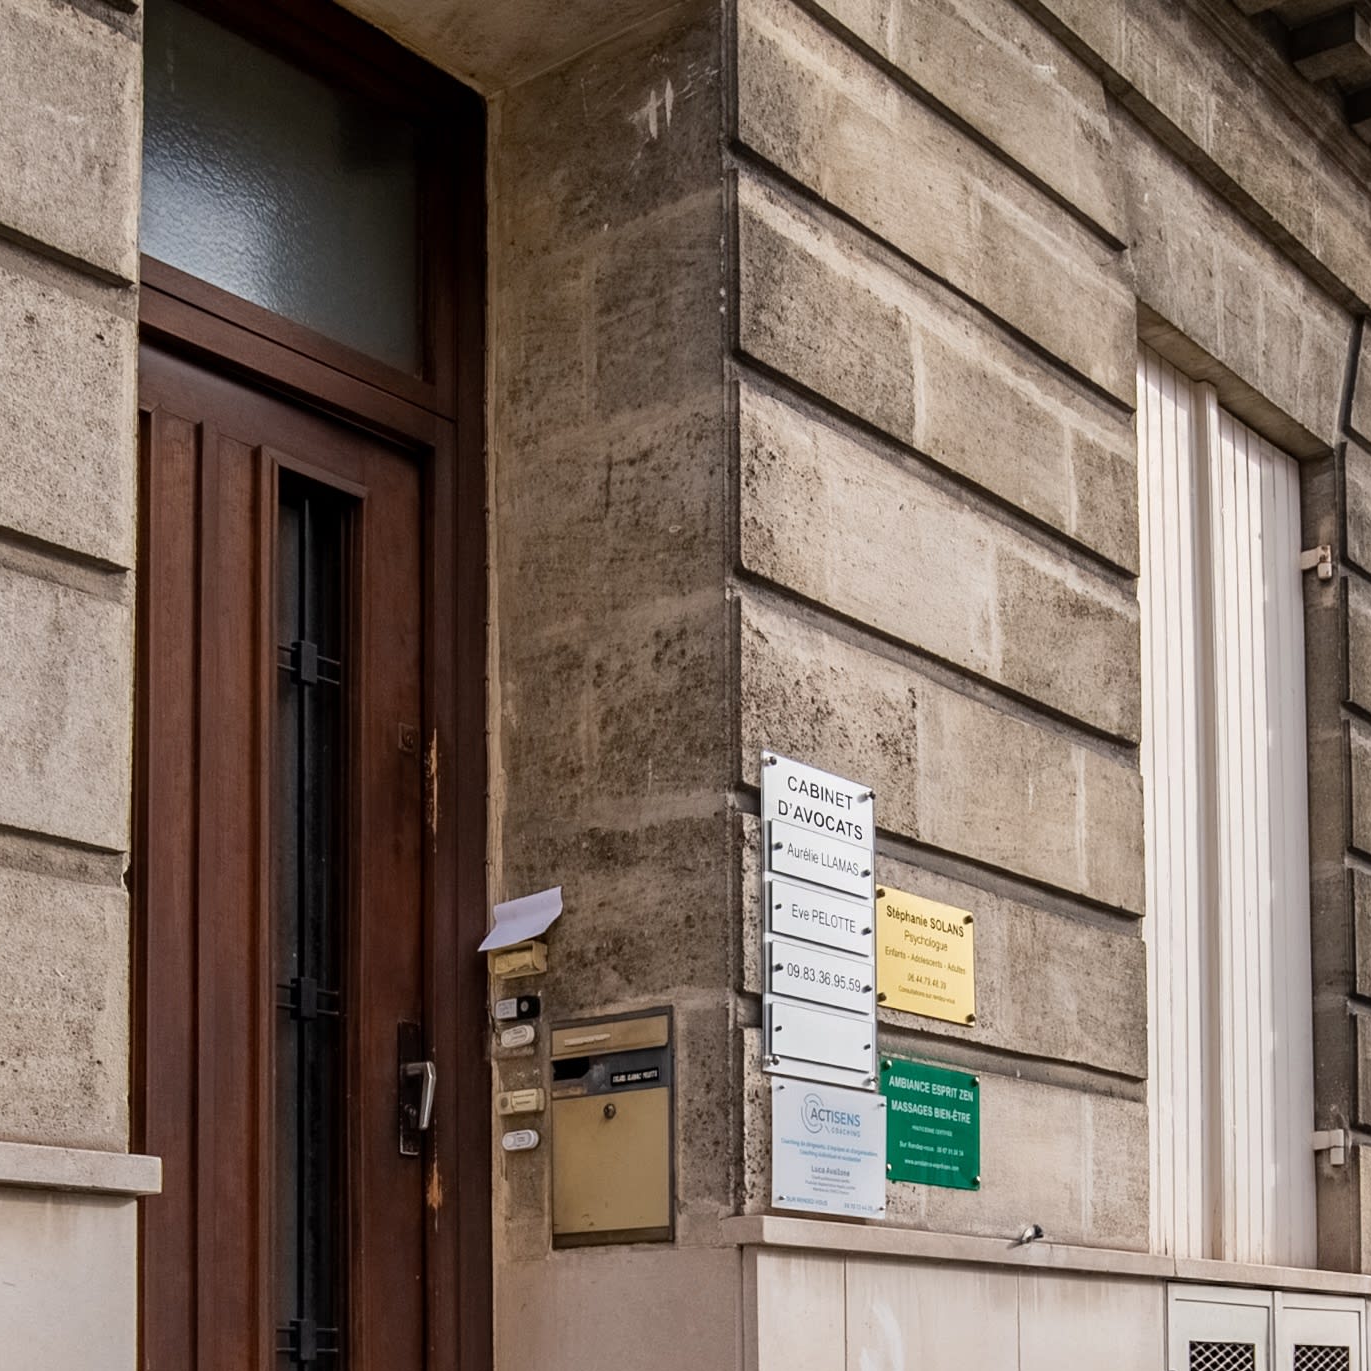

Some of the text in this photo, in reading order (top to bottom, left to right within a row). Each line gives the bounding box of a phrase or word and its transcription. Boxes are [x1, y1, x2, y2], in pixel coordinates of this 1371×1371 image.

[787, 776, 853, 811] CABINET
[778, 800, 863, 841] D'AVOCATS
[787, 843, 859, 877] Aurélie LLAMAS
[791, 904, 856, 934] Eve PELOTTE
[886, 905, 964, 938] Stéphanie SOLANS
[904, 930, 948, 952] Psychologue
[787, 963, 861, 992] 09.83.36.95.59
[889, 1076, 973, 1102] AMBIANCE ESPRIT ZEN
[810, 1107, 861, 1127] ACTISENS
[891, 1100, 933, 1117] MASSAGES
